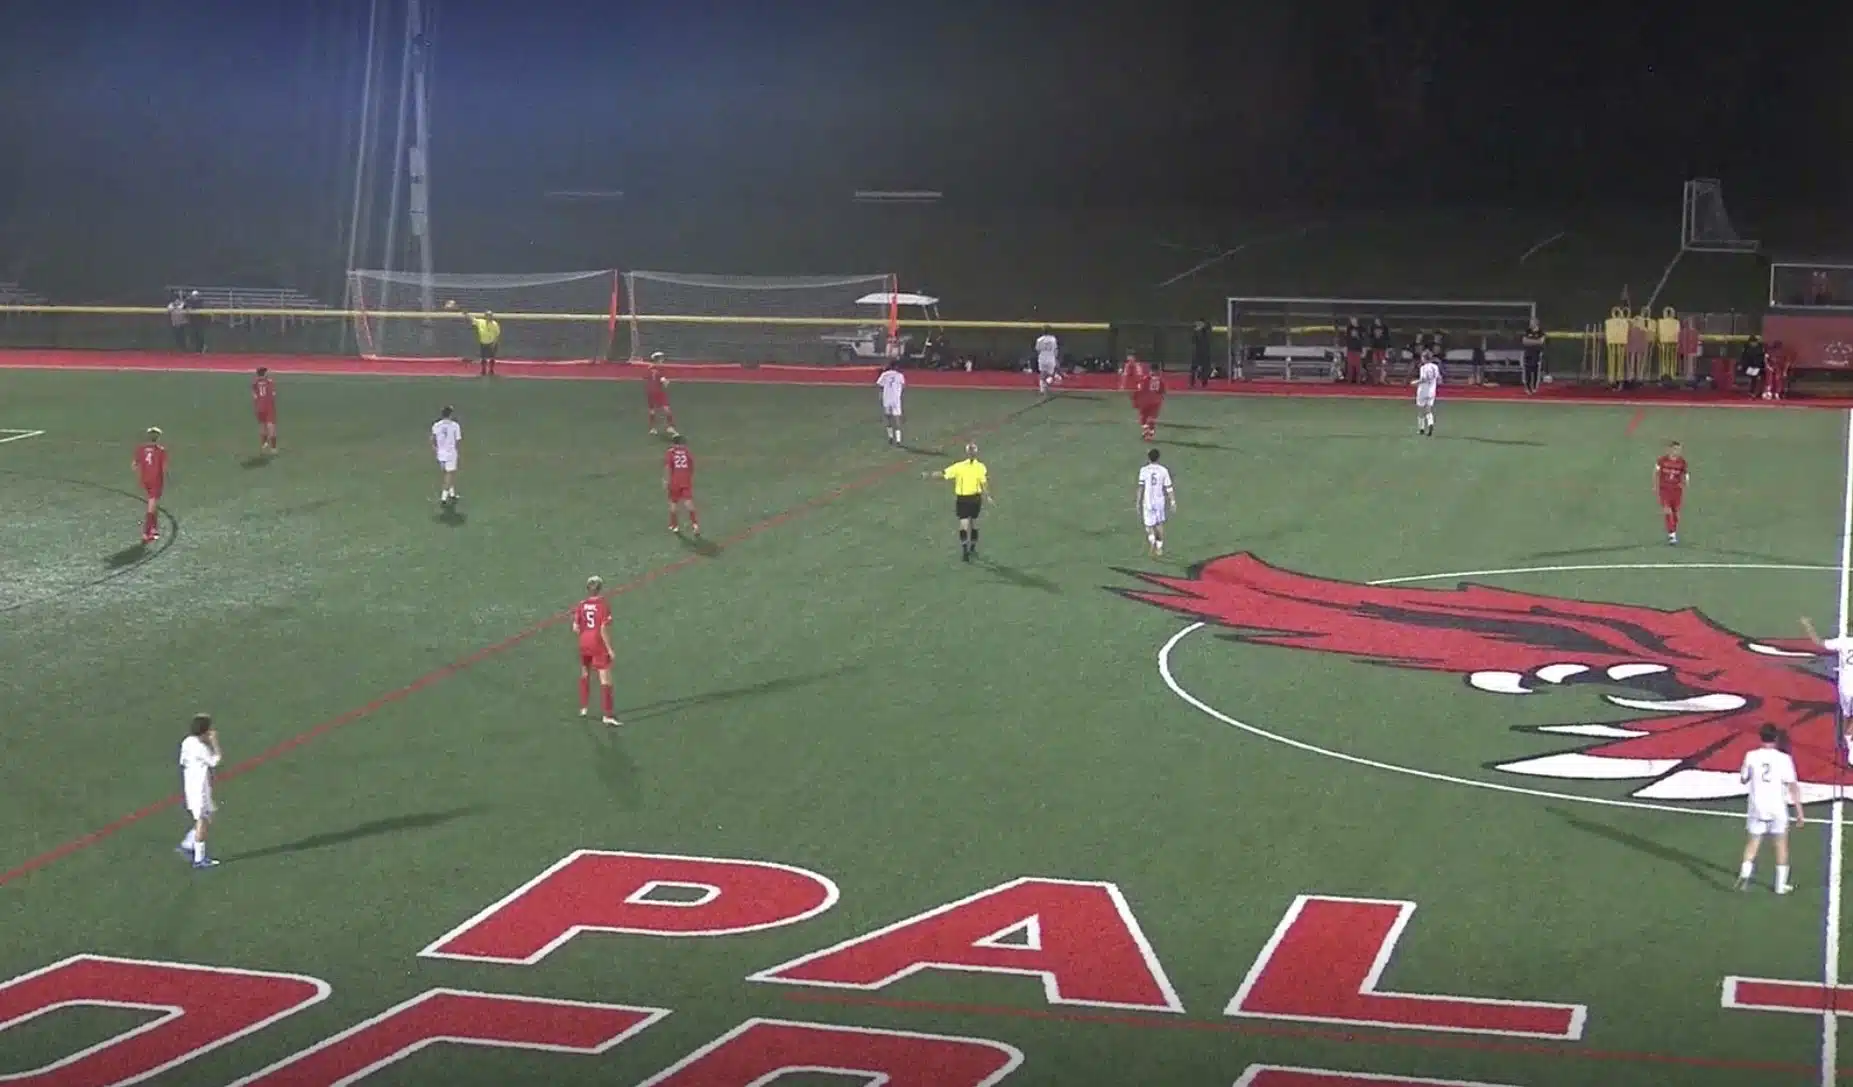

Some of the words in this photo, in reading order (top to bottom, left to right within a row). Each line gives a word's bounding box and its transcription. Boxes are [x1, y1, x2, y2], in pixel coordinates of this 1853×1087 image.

[144, 451, 153, 466] 4
[673, 454, 689, 469] 22
[1150, 472, 1158, 486] 6
[586, 610, 596, 629] 5
[1761, 763, 1771, 783] 2
